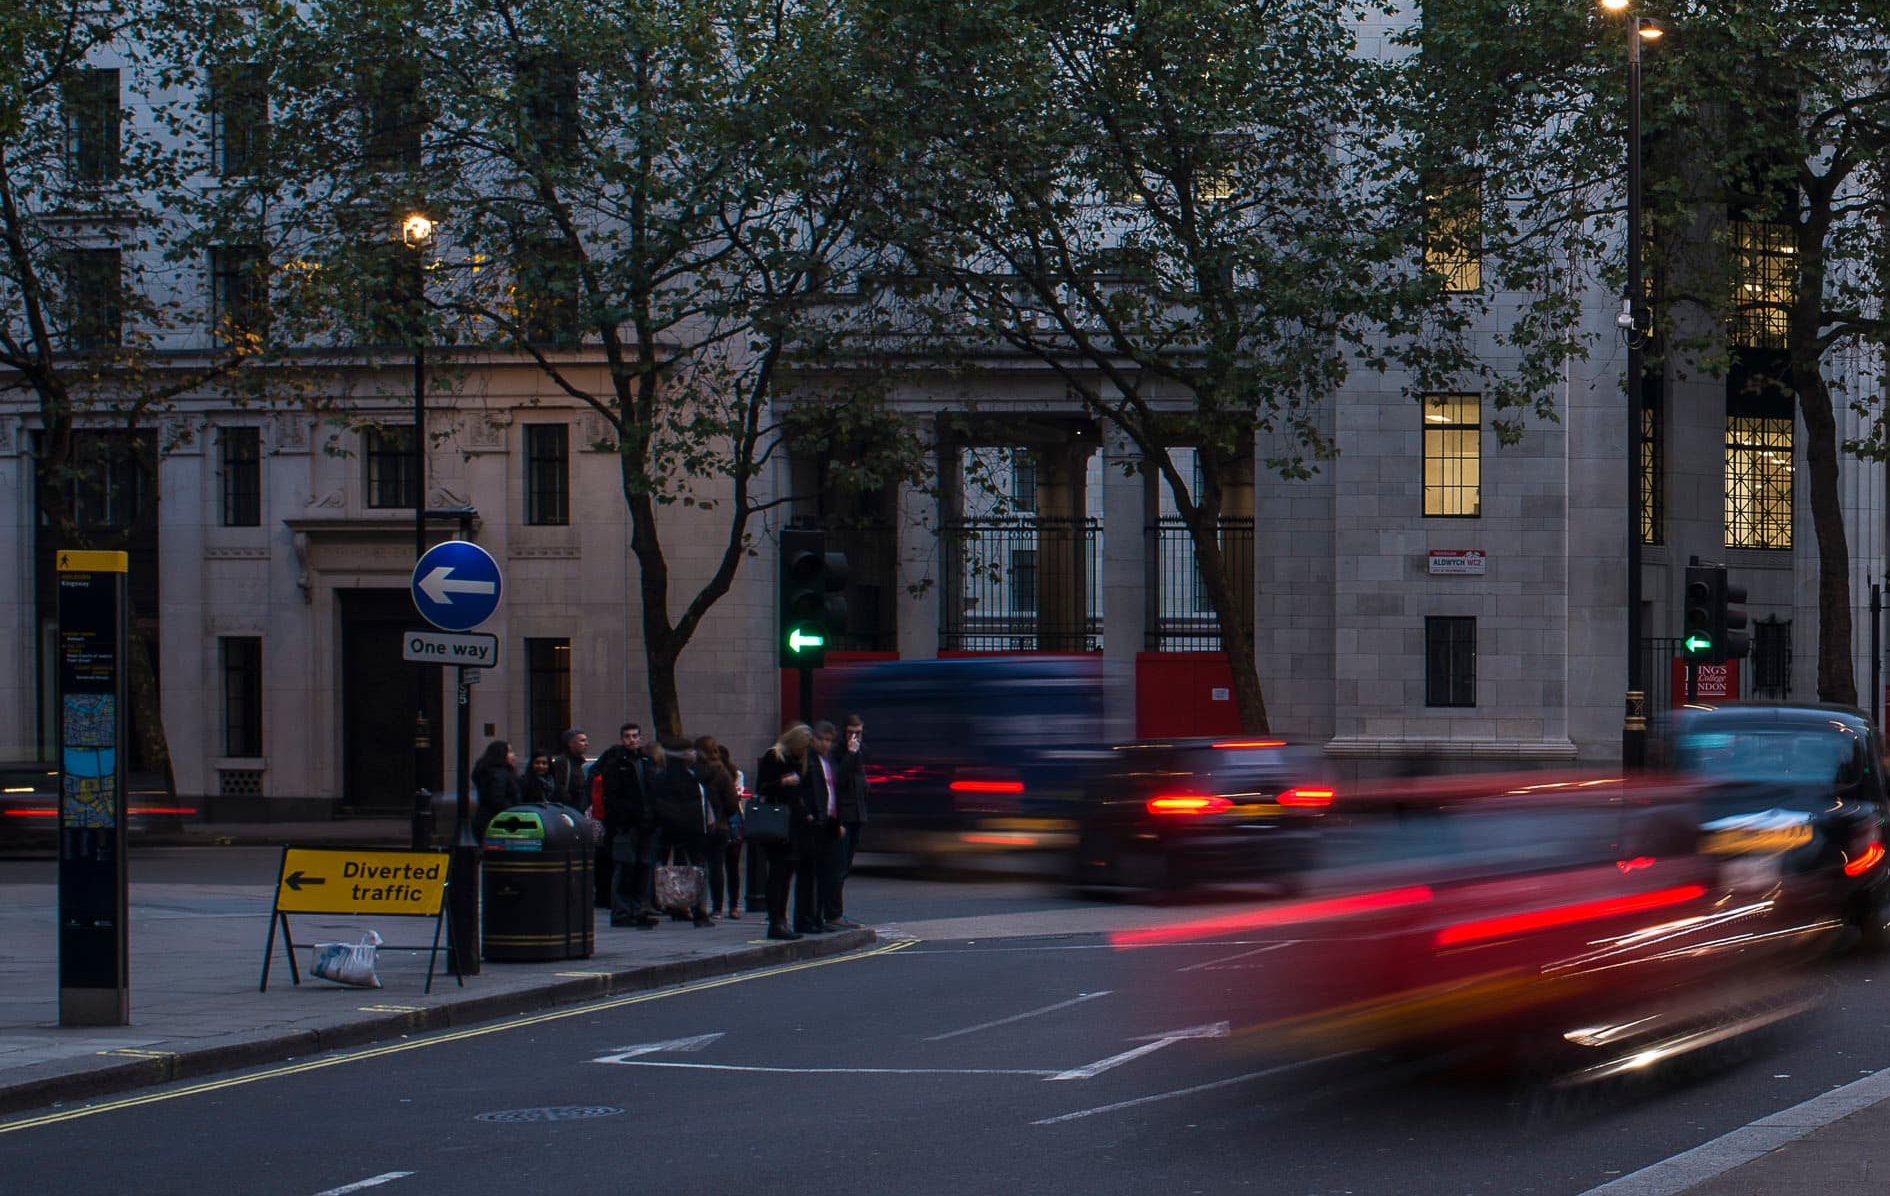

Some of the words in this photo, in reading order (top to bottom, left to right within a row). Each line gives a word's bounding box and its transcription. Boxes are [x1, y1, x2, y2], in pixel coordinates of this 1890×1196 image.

[411, 638, 447, 654] One
[453, 644, 488, 660] way
[343, 861, 440, 881] Diverted
[352, 884, 423, 901] traffic
